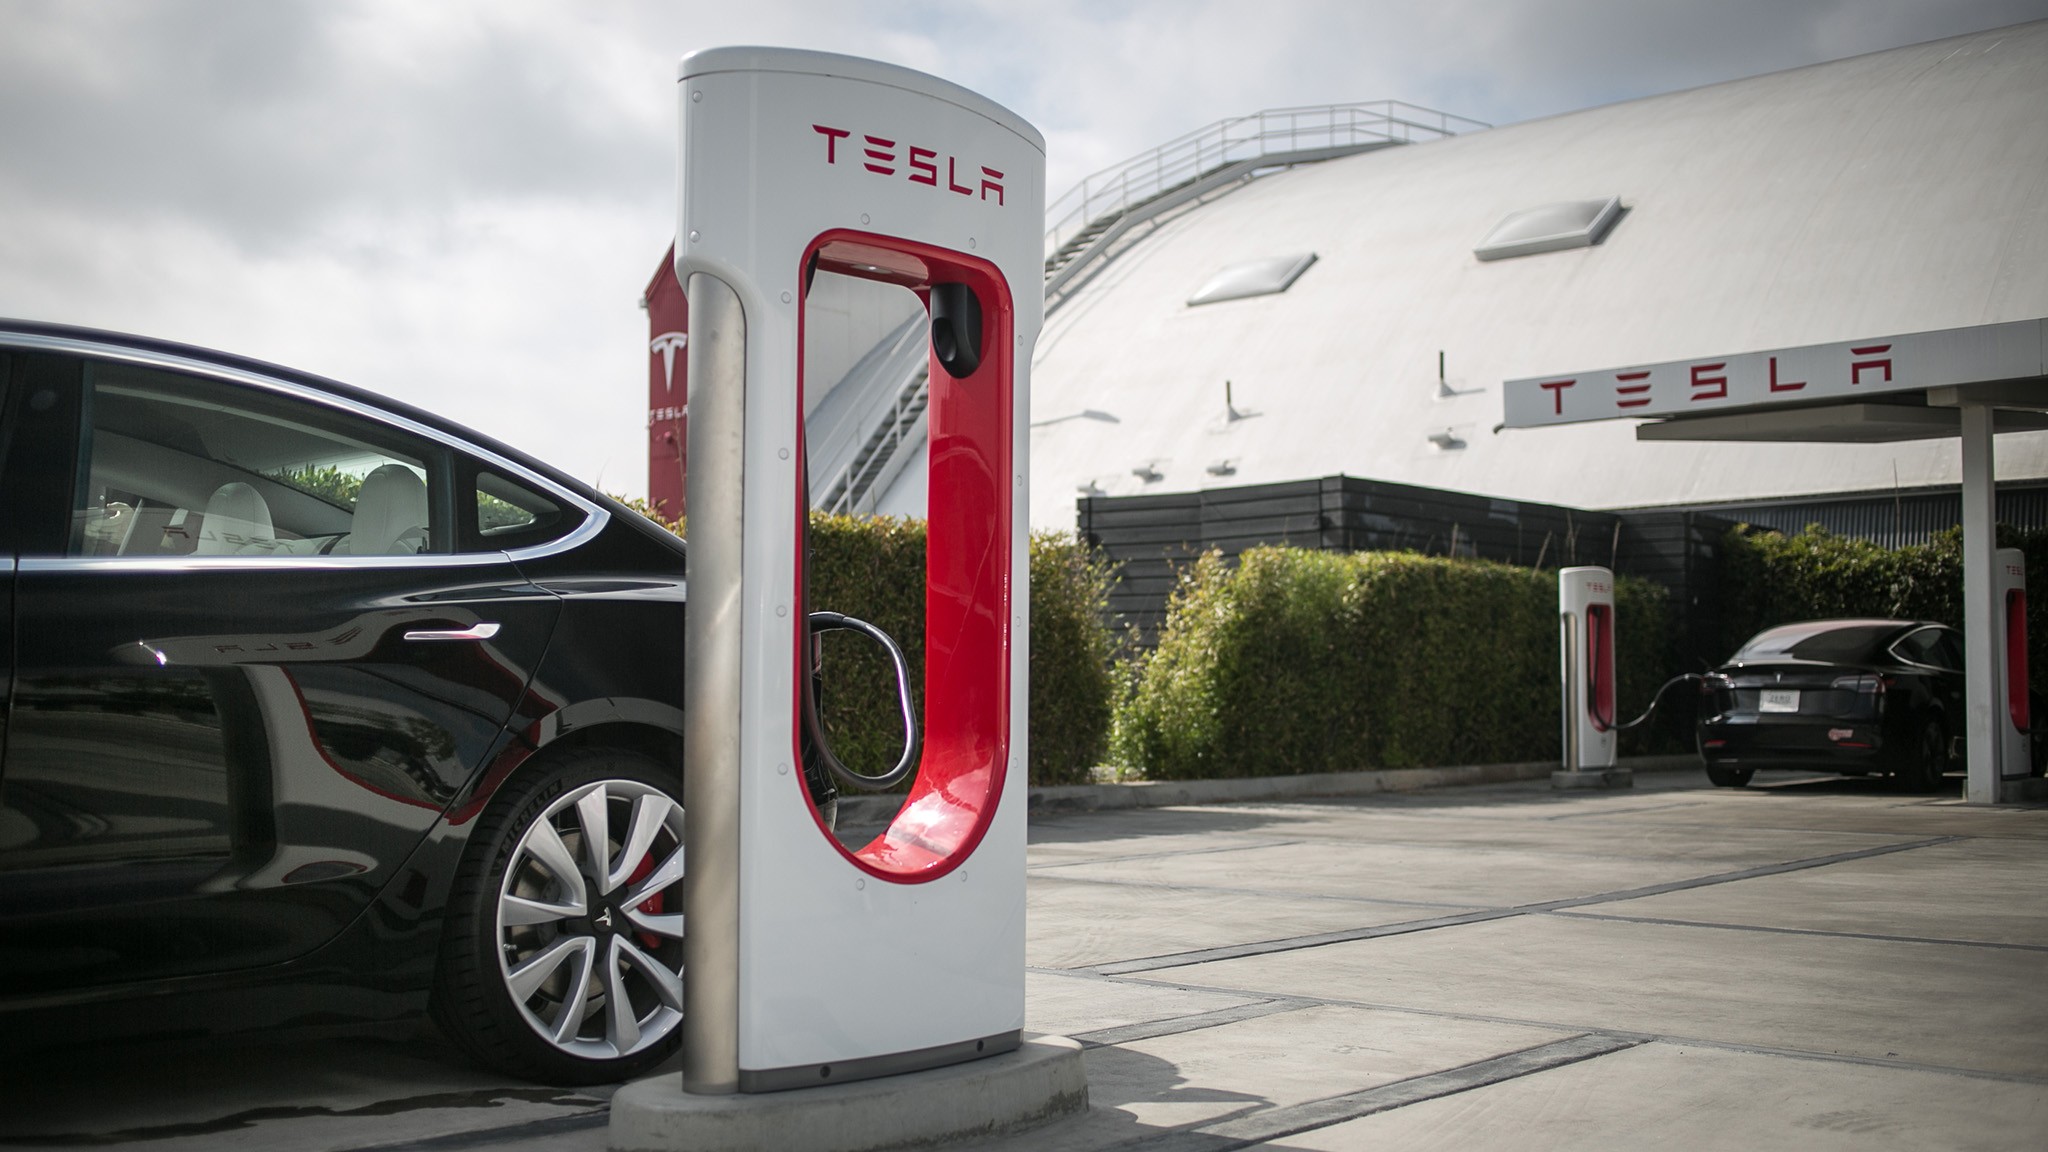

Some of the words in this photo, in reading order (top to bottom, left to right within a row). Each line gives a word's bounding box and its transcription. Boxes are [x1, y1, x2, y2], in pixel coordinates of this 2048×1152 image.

[811, 123, 1004, 206] TESLA
[1540, 344, 1893, 415] TESLA
[500, 778, 563, 852] MICHELIN
